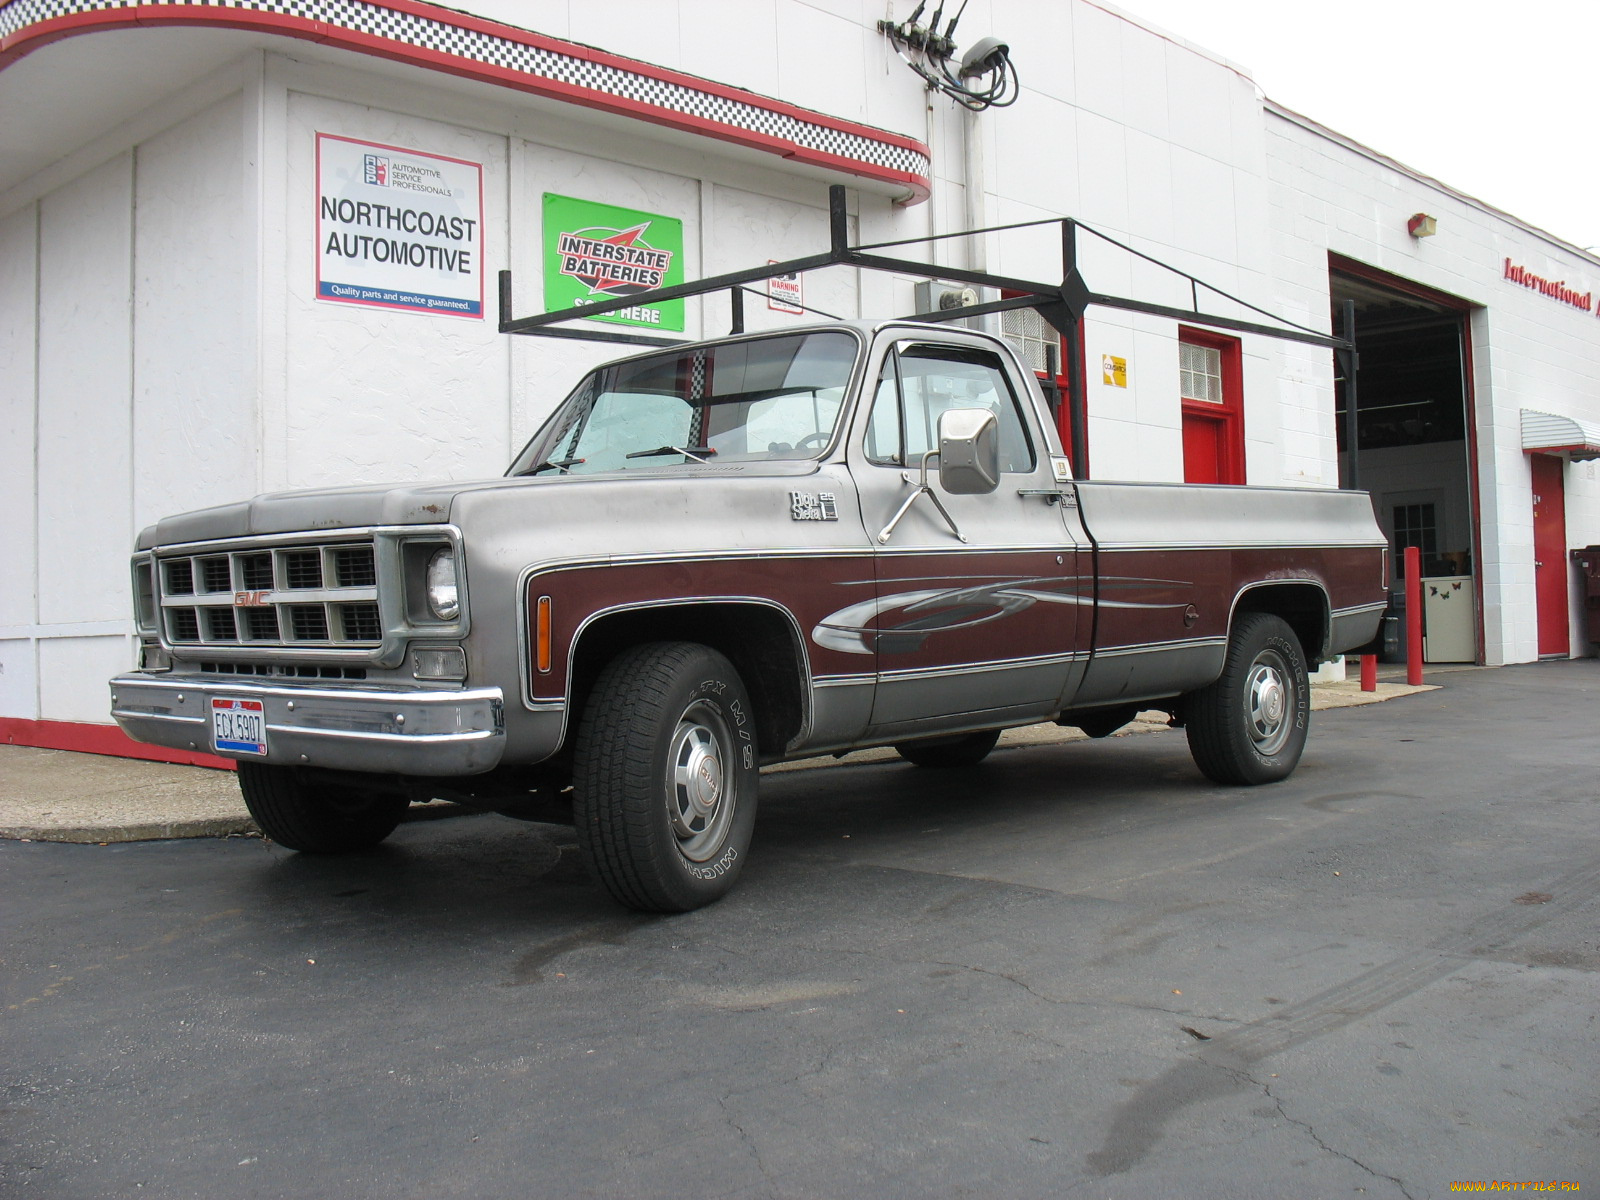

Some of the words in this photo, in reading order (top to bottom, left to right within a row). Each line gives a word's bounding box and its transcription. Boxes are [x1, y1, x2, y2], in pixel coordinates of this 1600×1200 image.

[392, 163, 441, 179] AUTOMOTIVE
[392, 171, 422, 184] SERVICE
[392, 180, 452, 197] PROFESSIONALS
[321, 195, 476, 242] NORTHCOAST
[325, 231, 471, 274] AUTOMOTIVE
[561, 236, 668, 269] INTERSTATE
[564, 256, 661, 287] BATTERIES
[771, 279, 799, 293] WARNING
[1503, 256, 1592, 312] International
[331, 284, 361, 298] Quality
[362, 289, 382, 299] parts
[383, 291, 398, 301] and
[399, 294, 426, 305] service
[620, 306, 660, 324] HERE
[790, 490, 818, 509] High
[819, 492, 836, 502] 25
[234, 591, 271, 607] GMC
[215, 712, 236, 740] ECX
[236, 714, 260, 742] 5907
